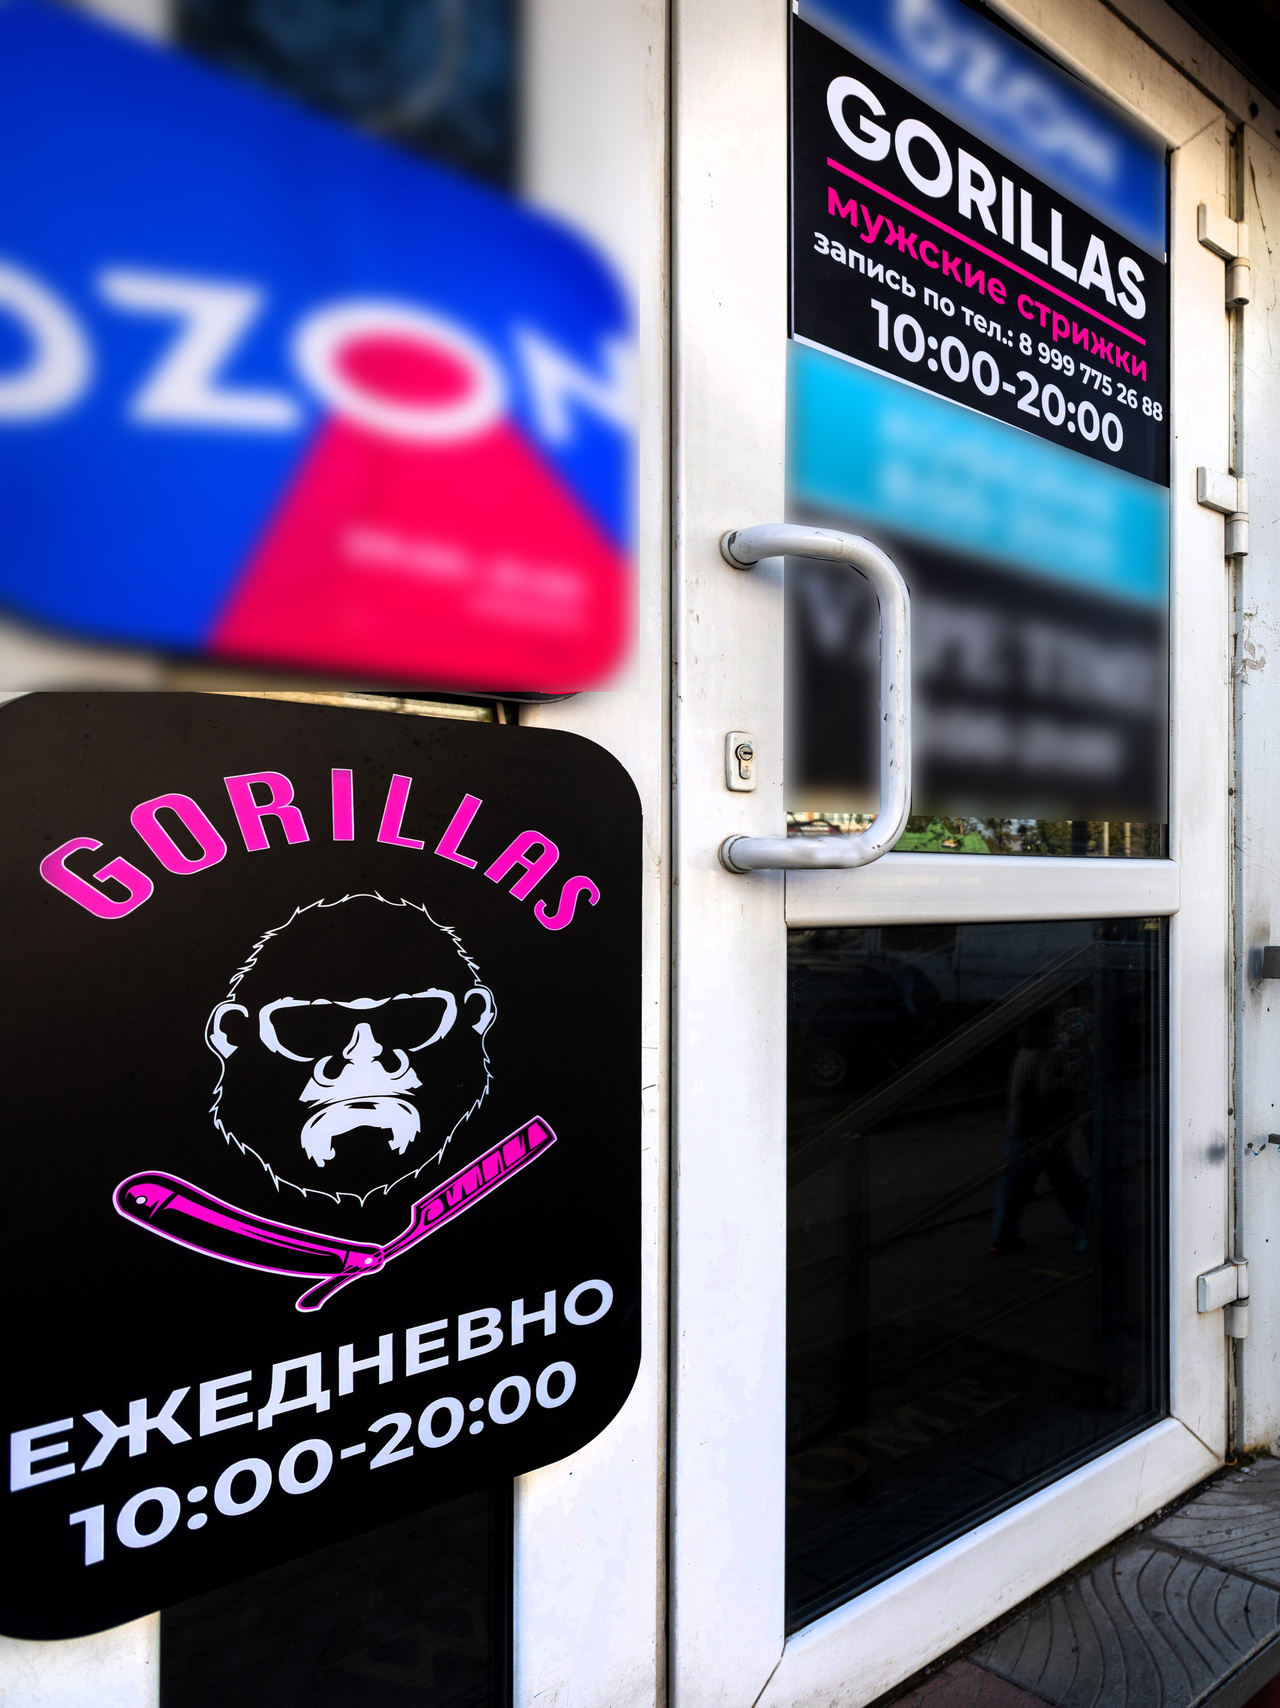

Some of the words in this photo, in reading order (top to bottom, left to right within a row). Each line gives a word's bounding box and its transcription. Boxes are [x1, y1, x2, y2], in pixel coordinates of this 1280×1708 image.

[825, 75, 1147, 320] GORILLAS
[827, 185, 1007, 305] мужские
[1016, 293, 1148, 382] стрижки
[813, 231, 916, 298] запись
[924, 287, 954, 317] по
[960, 308, 1014, 348] тел.:
[1019, 332, 1032, 356] 8
[1038, 341, 1075, 377] 999
[1079, 362, 1113, 395] 775
[1116, 382, 1138, 408] 26
[1141, 395, 1163, 422] 88
[870, 298, 1124, 452] 10:00-20:00
[38, 766, 601, 933] GORILLAS
[9, 1279, 615, 1493] ЕЖЕДНЕВНО
[67, 1361, 577, 1566] 10:00-20:00
